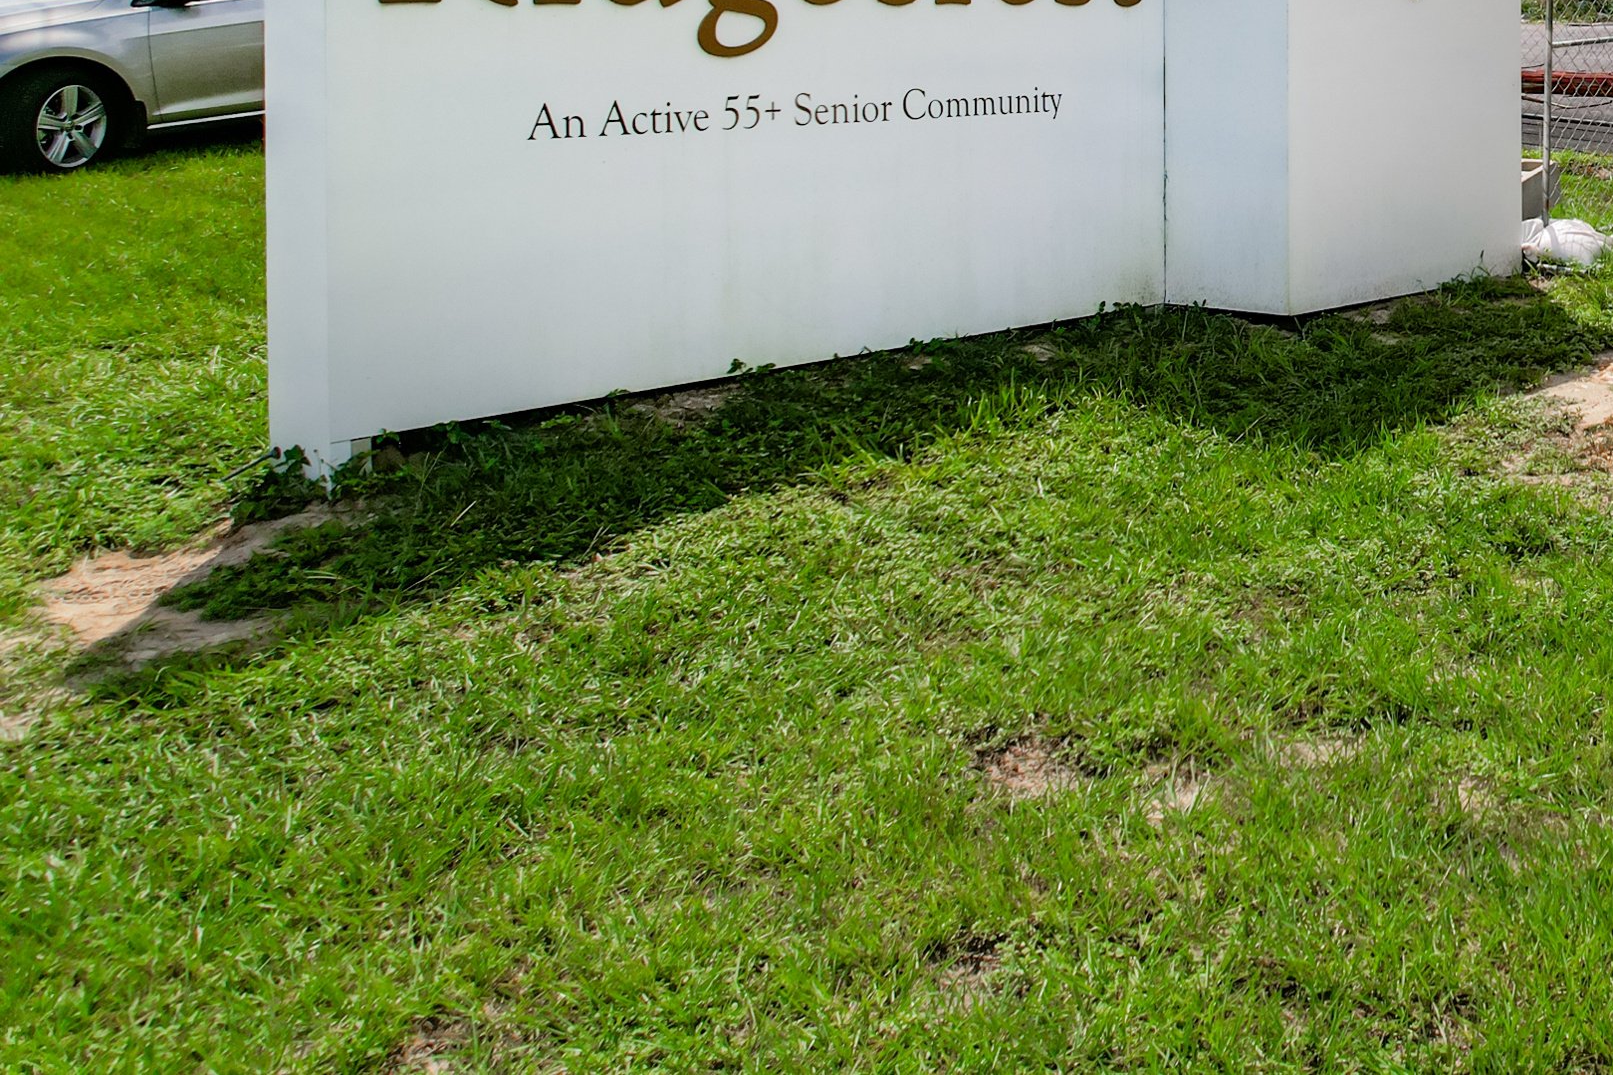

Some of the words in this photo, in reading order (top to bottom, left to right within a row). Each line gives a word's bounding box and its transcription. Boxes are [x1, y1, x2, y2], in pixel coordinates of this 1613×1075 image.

[527, 102, 587, 141] An
[598, 99, 709, 137] Active
[722, 94, 782, 131] 55+
[794, 92, 893, 127] Senior
[902, 87, 1063, 121] Community
